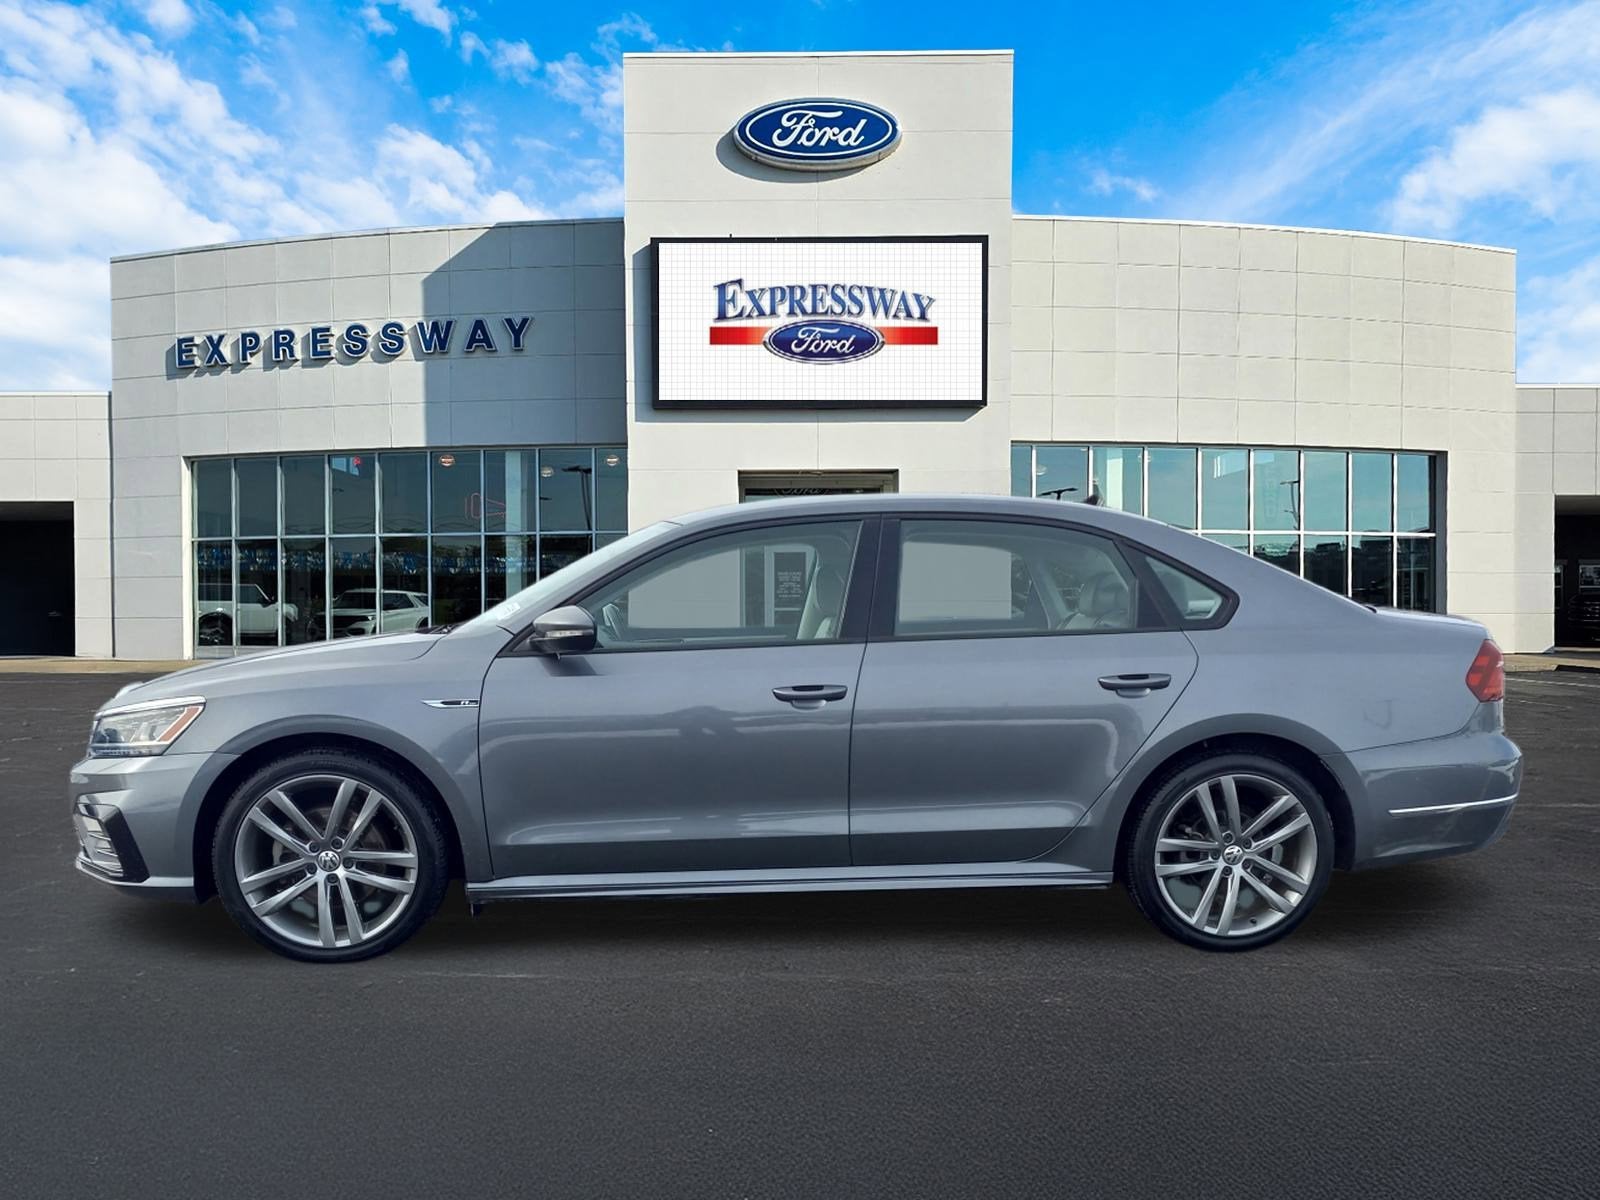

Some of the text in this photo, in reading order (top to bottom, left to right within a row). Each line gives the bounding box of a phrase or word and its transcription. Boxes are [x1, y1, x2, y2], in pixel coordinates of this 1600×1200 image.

[771, 110, 867, 147] Ford
[174, 315, 533, 368] EXPRESSWAY
[791, 326, 854, 354] Ford
